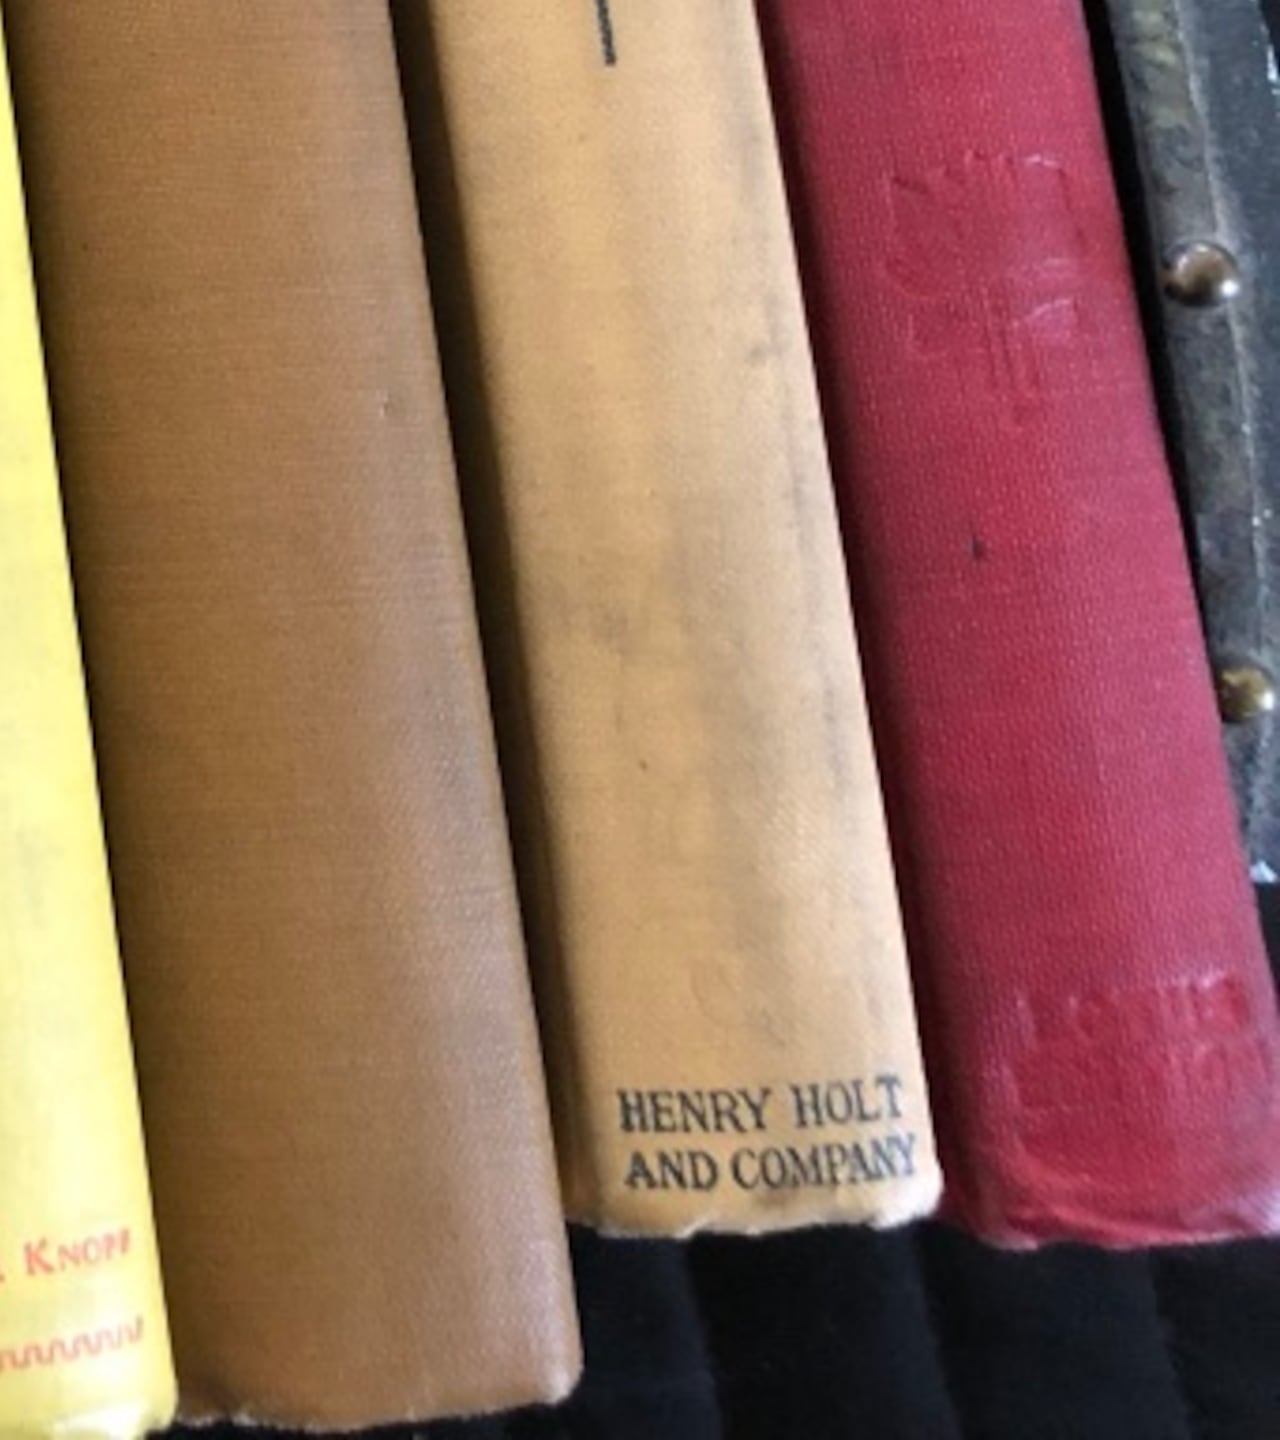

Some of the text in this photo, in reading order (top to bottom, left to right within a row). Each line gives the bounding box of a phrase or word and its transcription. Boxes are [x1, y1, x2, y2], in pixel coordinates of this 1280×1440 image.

[617, 1075, 903, 1133] HENRY HOLT
[624, 1134, 917, 1191] AND COMPANY
